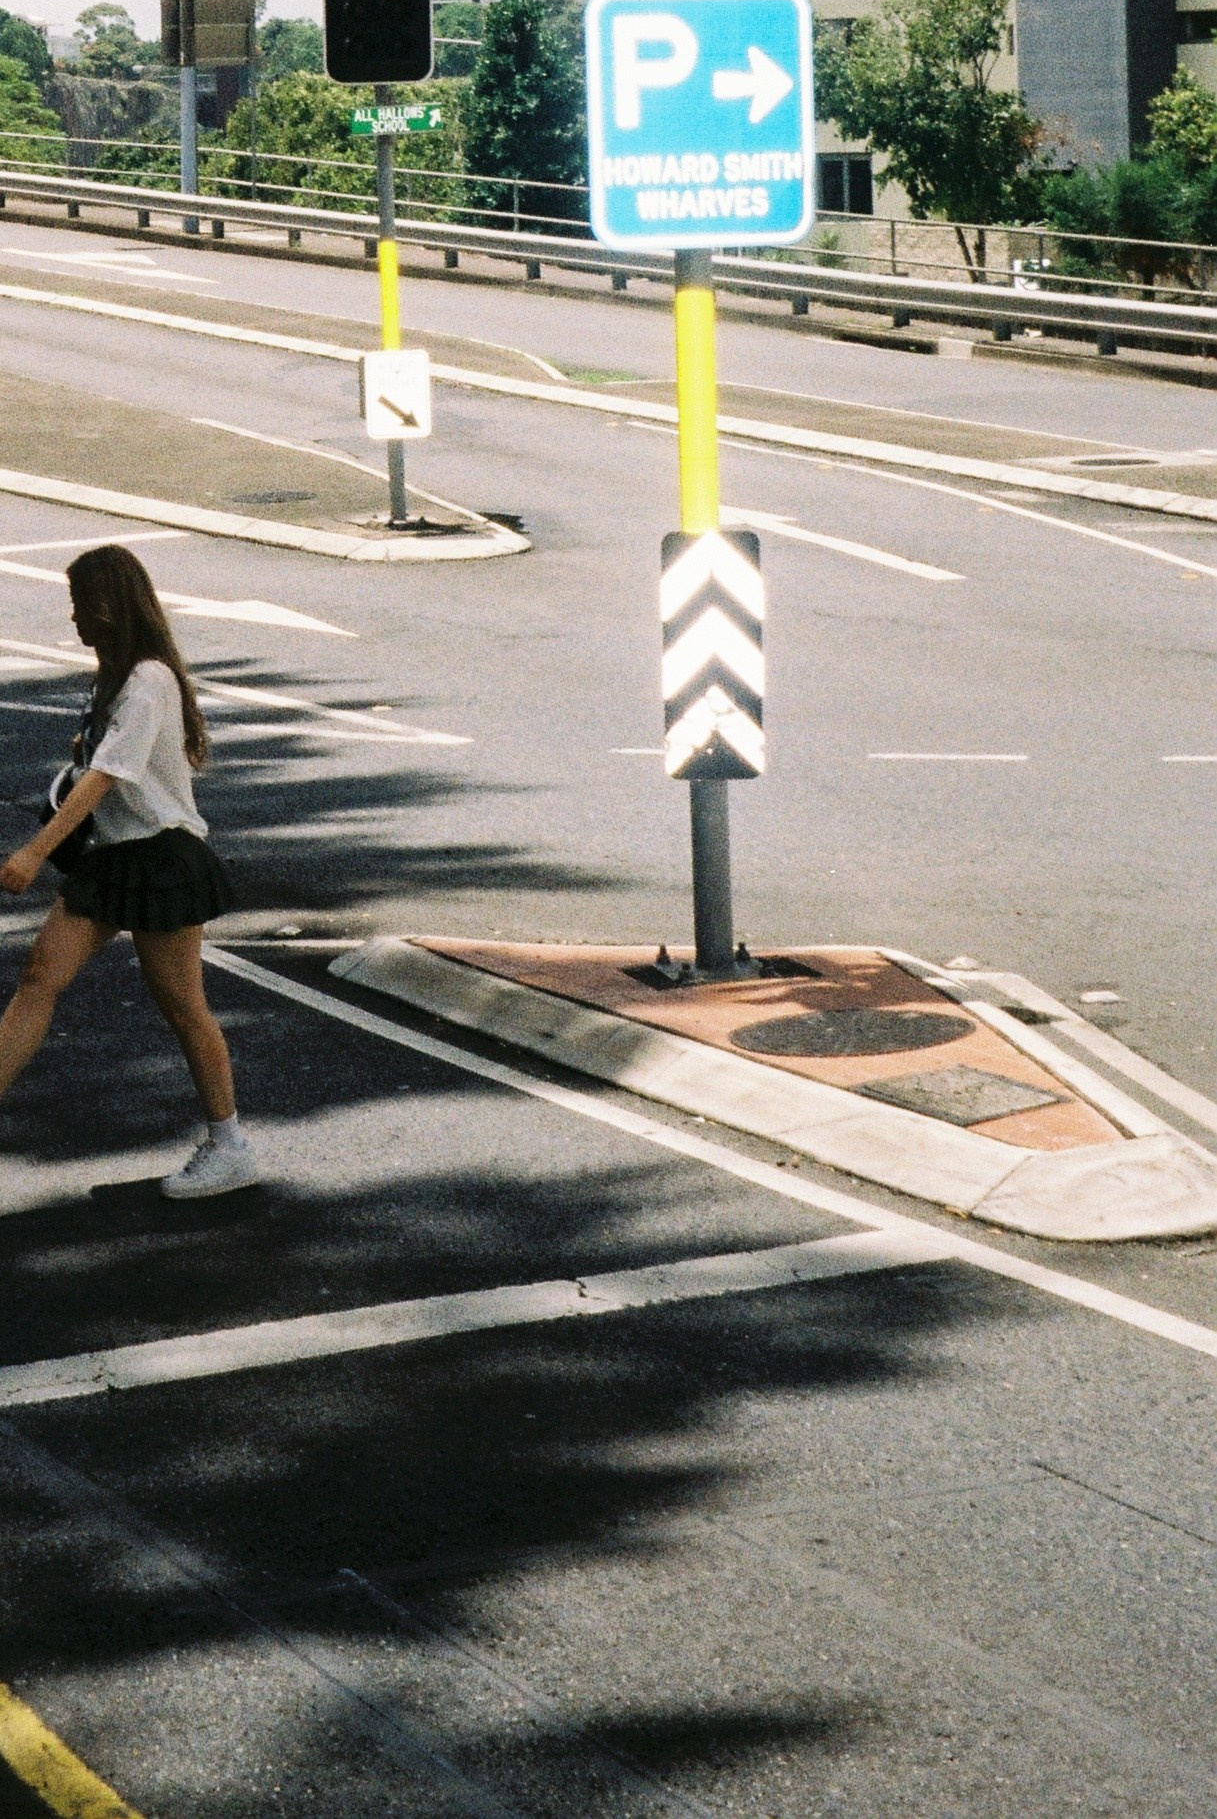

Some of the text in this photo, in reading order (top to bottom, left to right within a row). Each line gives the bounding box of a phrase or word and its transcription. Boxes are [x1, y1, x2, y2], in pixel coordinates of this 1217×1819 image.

[613, 13, 698, 129] P
[354, 109, 374, 122] ALL
[372, 119, 410, 133] SCHOOL
[604, 152, 802, 185] HOWARD SMITH
[637, 187, 769, 219] WHARVES
